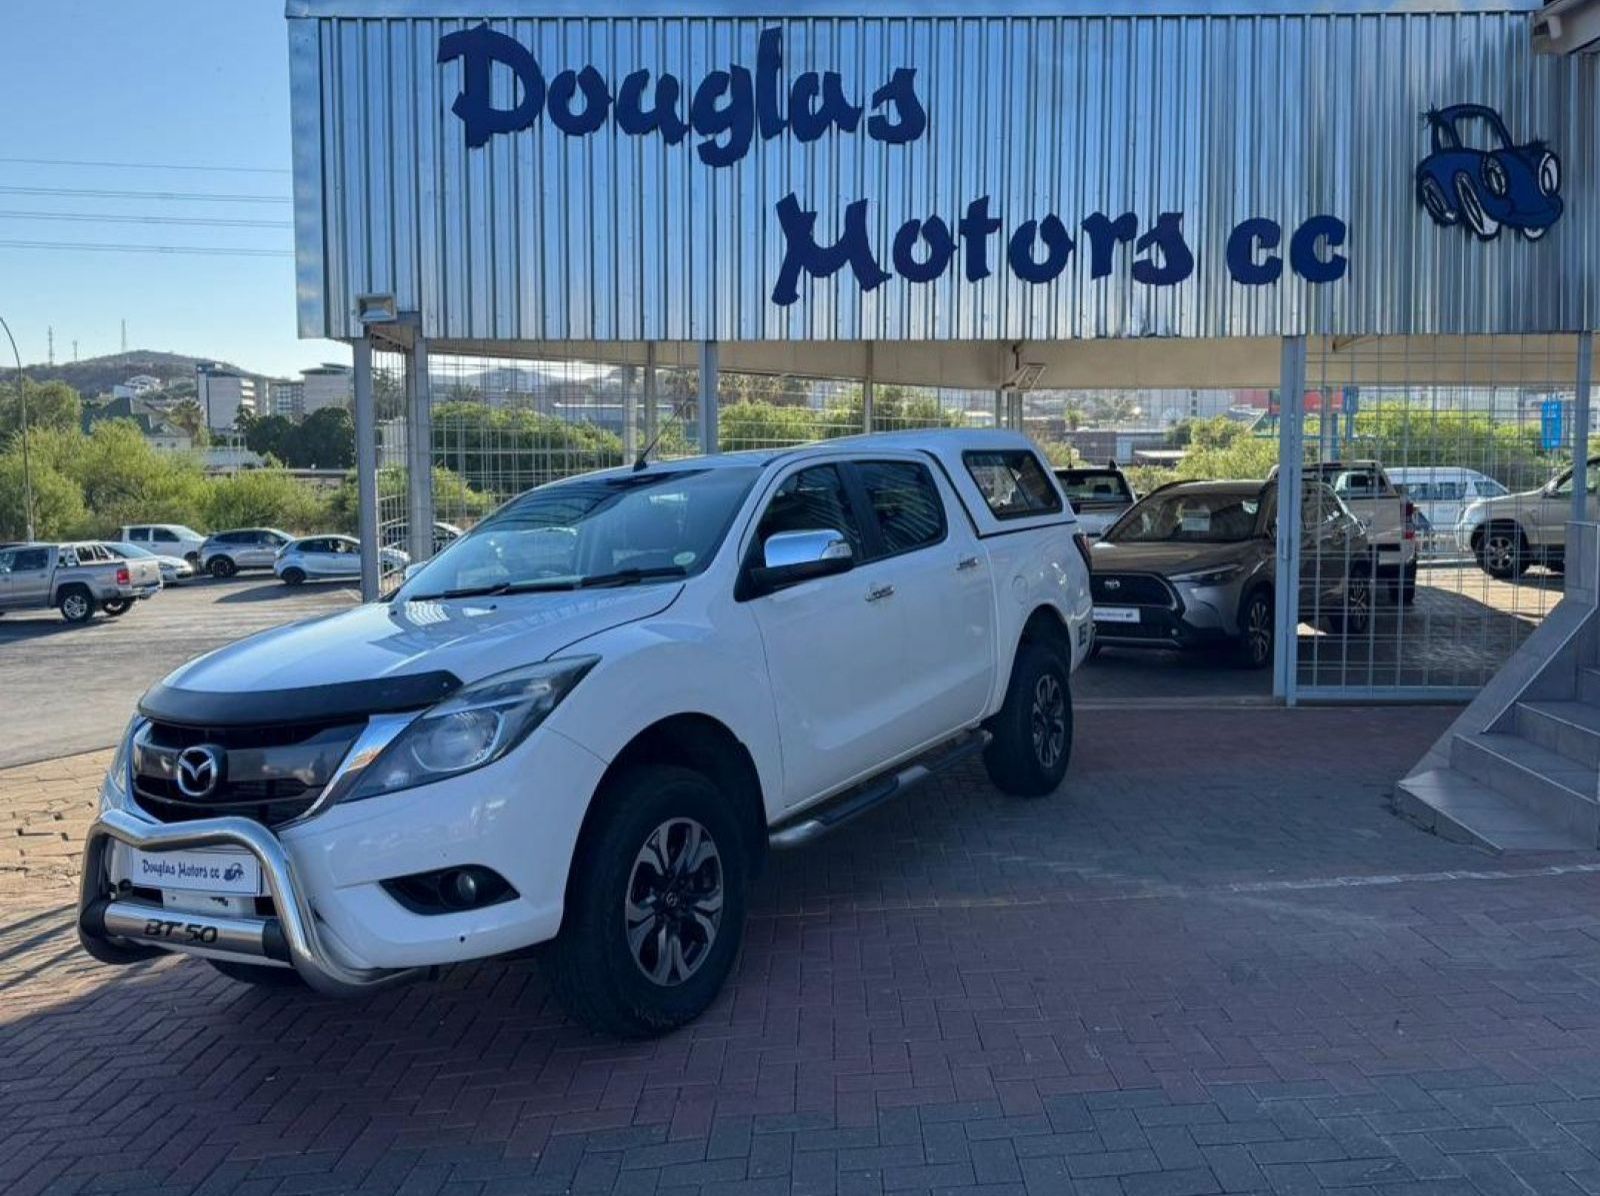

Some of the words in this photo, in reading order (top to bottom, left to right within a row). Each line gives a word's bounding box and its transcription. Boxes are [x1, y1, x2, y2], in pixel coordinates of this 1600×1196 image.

[437, 22, 927, 167] Douglas
[772, 193, 1194, 305] Motors
[1226, 214, 1349, 284] cc
[142, 859, 176, 876] Douglas
[178, 862, 208, 879] Motors
[209, 868, 220, 879] cc
